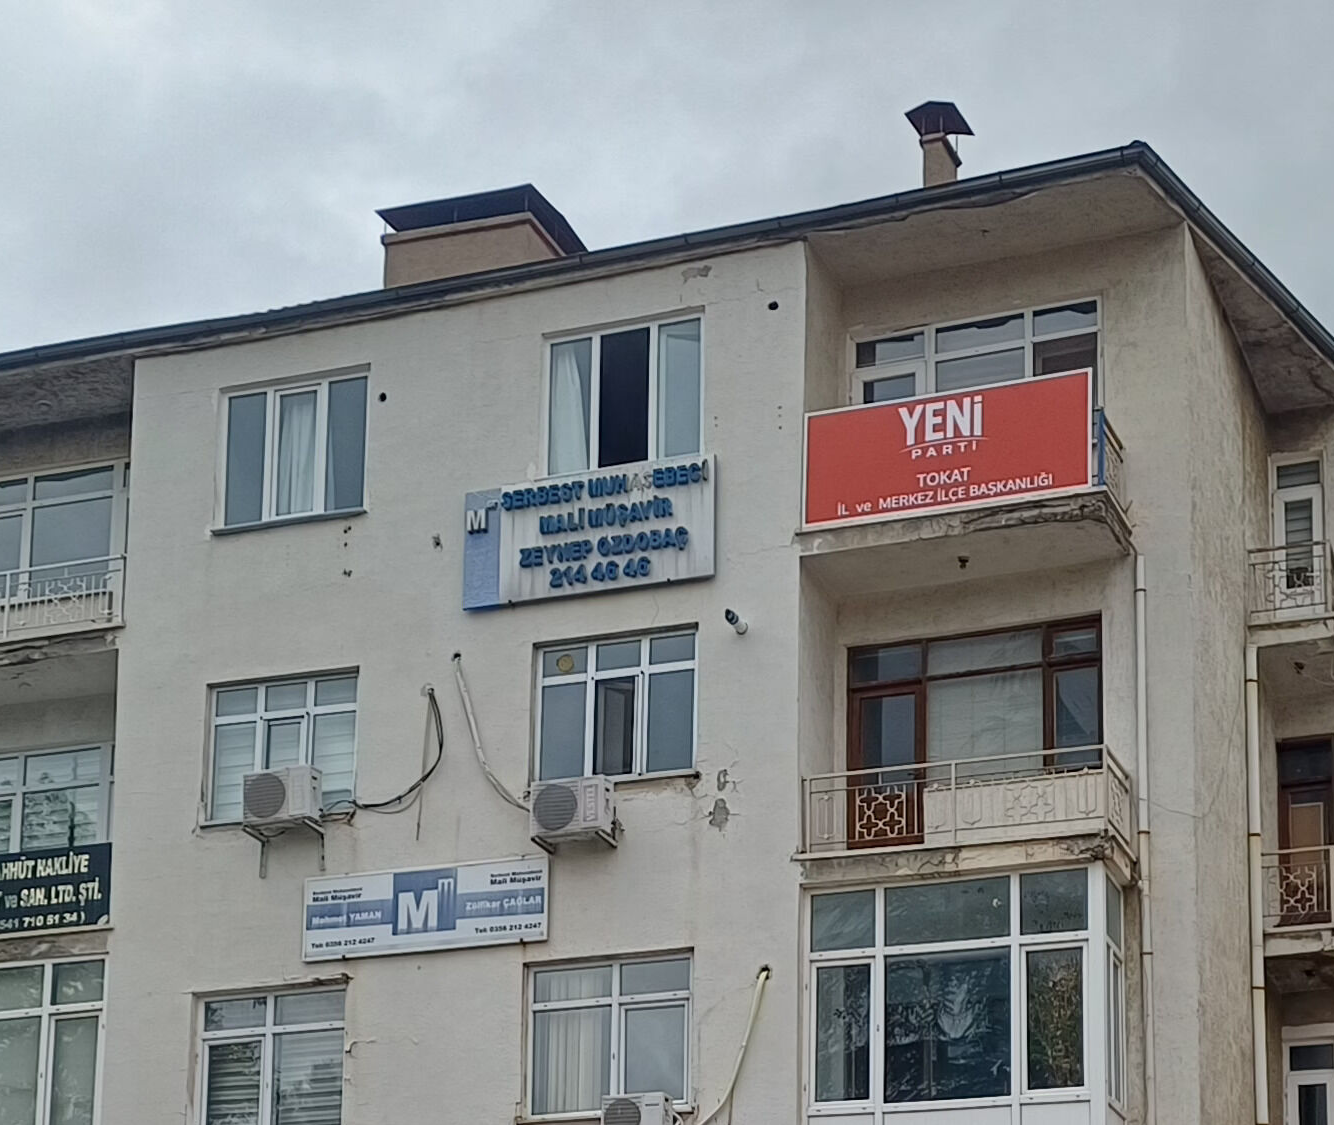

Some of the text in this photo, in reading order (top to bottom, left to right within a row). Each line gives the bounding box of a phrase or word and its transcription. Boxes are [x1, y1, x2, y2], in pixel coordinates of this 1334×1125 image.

[917, 467, 971, 488] TOKAT
[501, 481, 585, 511] SERBEST
[856, 502, 872, 513] ve
[879, 489, 934, 511] MERKEZ
[937, 486, 966, 503] İLÇE
[970, 471, 1053, 498] BAŞKANLIĞI
[520, 539, 593, 568] ZEYNEP
[550, 565, 587, 588] 214
[36, 851, 89, 878] NAKLİYE
[5, 894, 18, 908] ve
[50, 885, 76, 904] LTD.
[78, 877, 102, 906] ŞTİ.
[23, 915, 43, 927] 710
